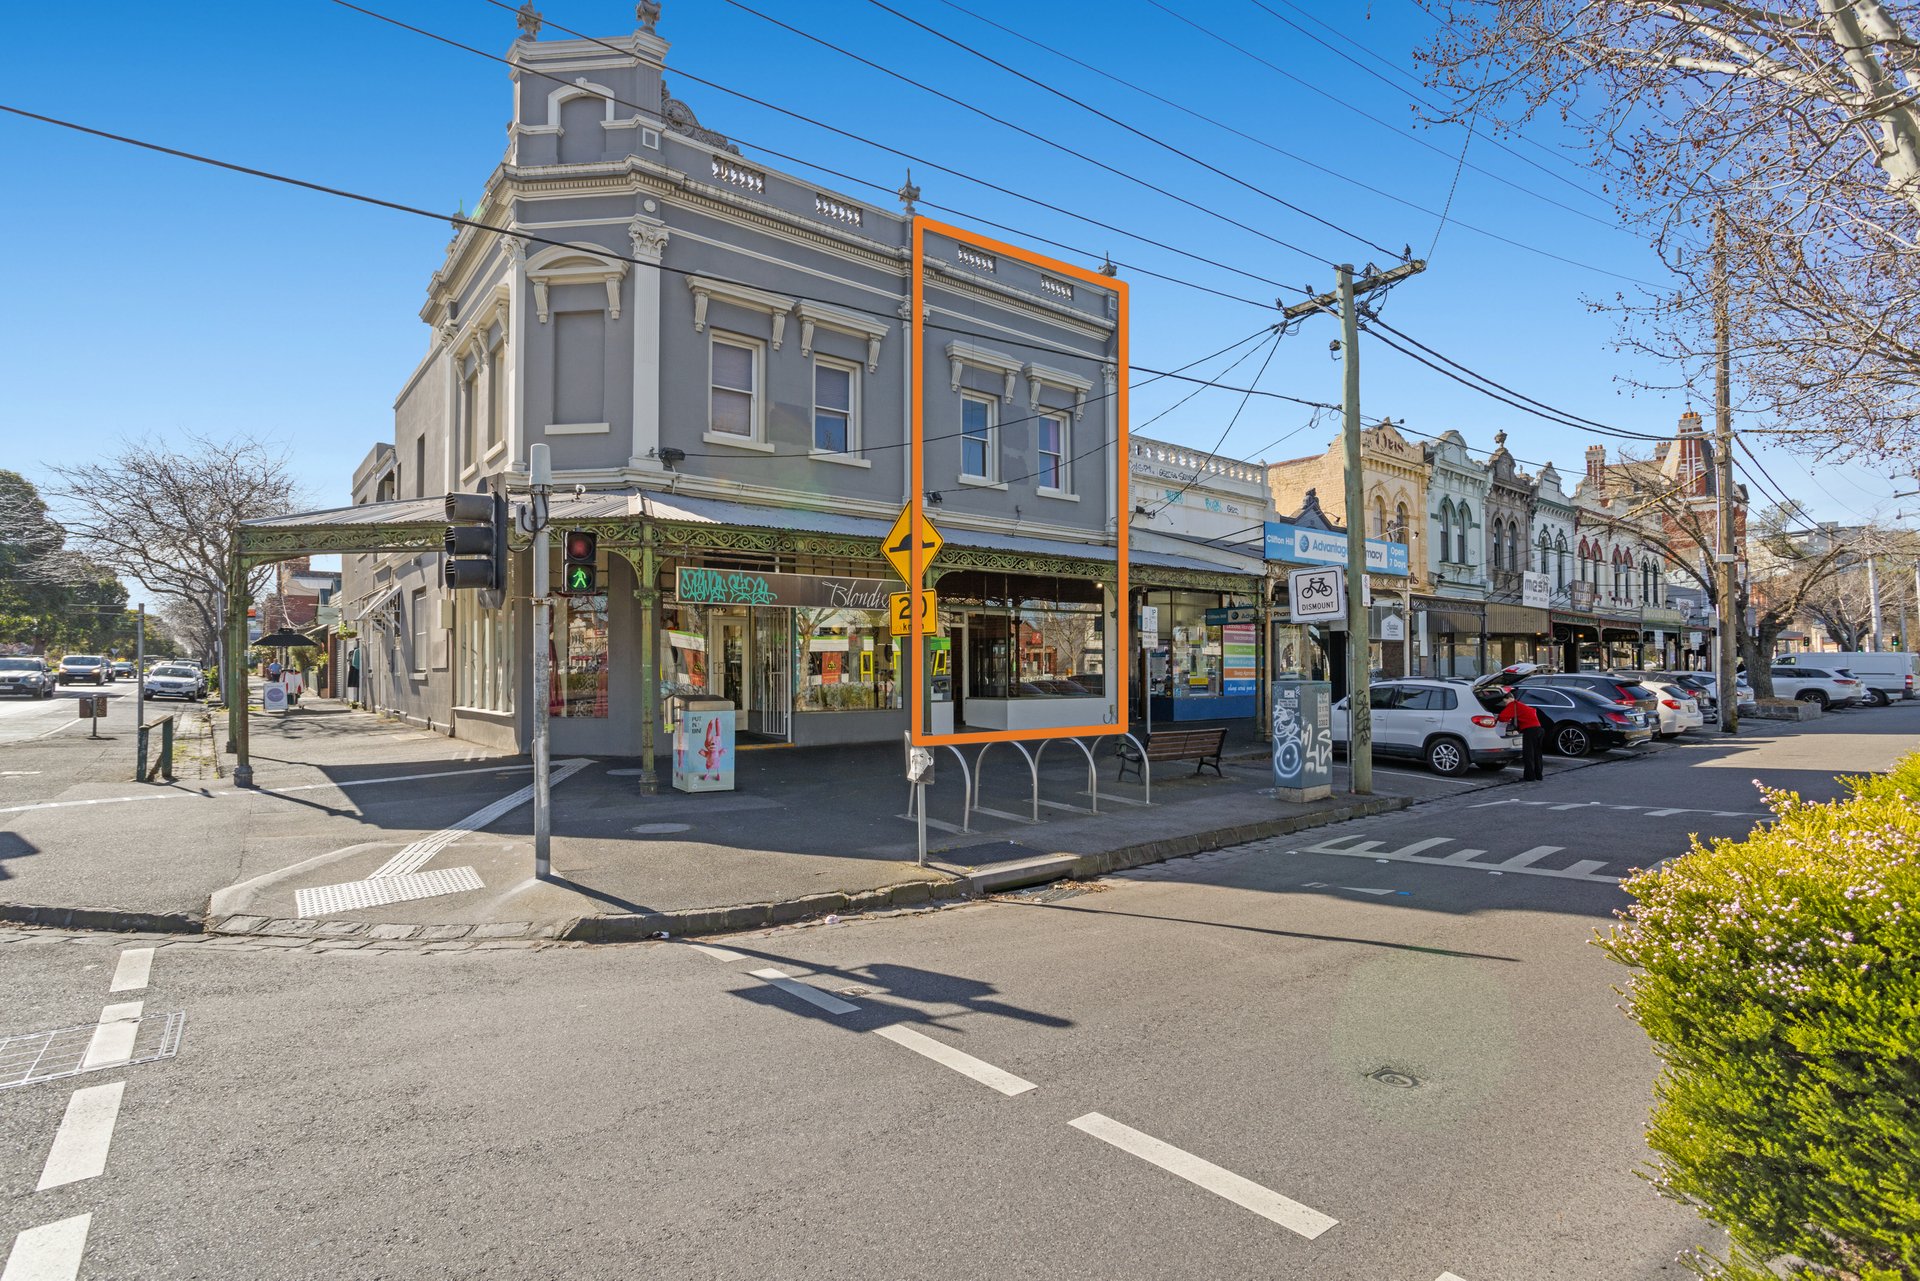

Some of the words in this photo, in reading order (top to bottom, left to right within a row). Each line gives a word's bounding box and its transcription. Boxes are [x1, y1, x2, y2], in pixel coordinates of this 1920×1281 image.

[1266, 534, 1284, 545] Clifton
[1285, 536, 1294, 546] Hill
[1312, 540, 1348, 558] Advantag
[1390, 546, 1405, 556] Open
[1389, 558, 1393, 567] 7
[1394, 560, 1406, 569] Days
[1301, 601, 1334, 611] DISMOUNT
